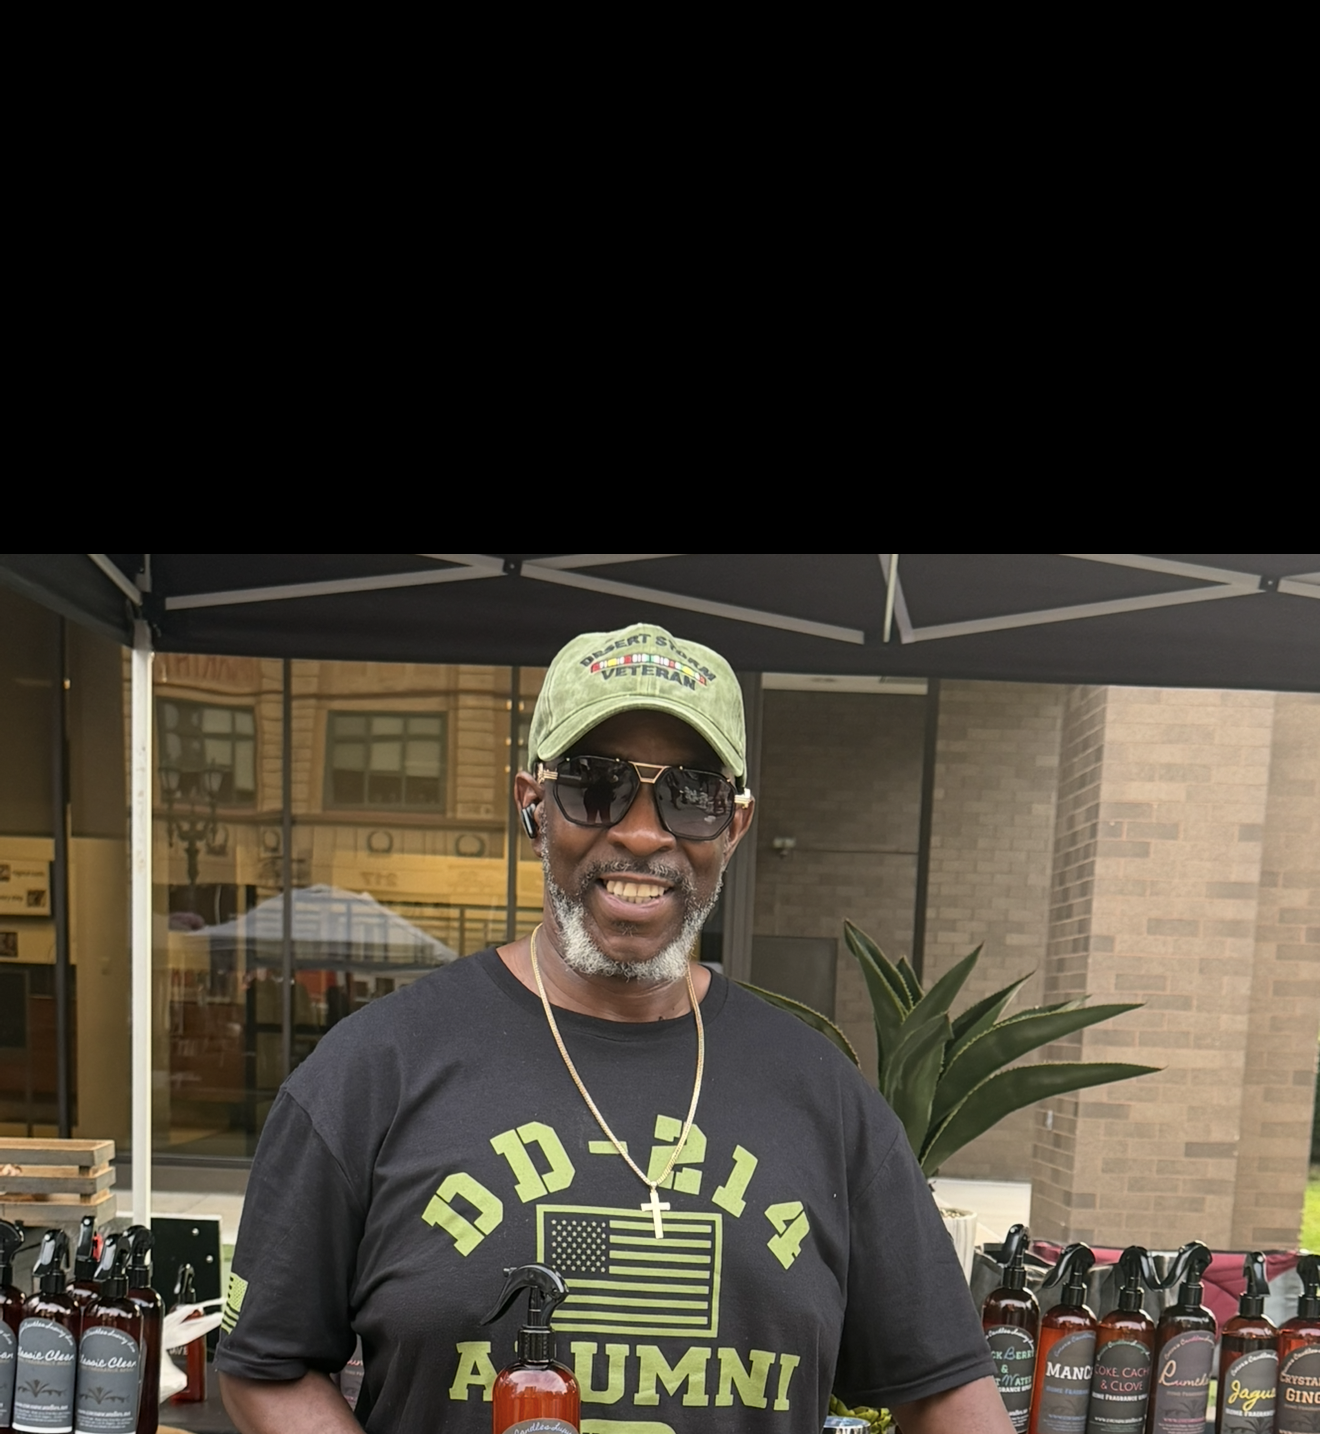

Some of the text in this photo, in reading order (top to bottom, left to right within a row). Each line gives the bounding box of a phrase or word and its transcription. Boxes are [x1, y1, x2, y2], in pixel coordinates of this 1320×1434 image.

[580, 633, 717, 682] DESERT STORM
[601, 664, 696, 691] VETERAN
[421, 1114, 811, 1270] DD-214
[448, 1340, 801, 1412] AUMNI
[1001, 1364, 1008, 1374] &
[1046, 1361, 1093, 1380] MANC
[1100, 1379, 1144, 1392] & CLOVE
[1280, 1374, 1320, 1387] CRYSTA
[1285, 1387, 1320, 1404] GING
